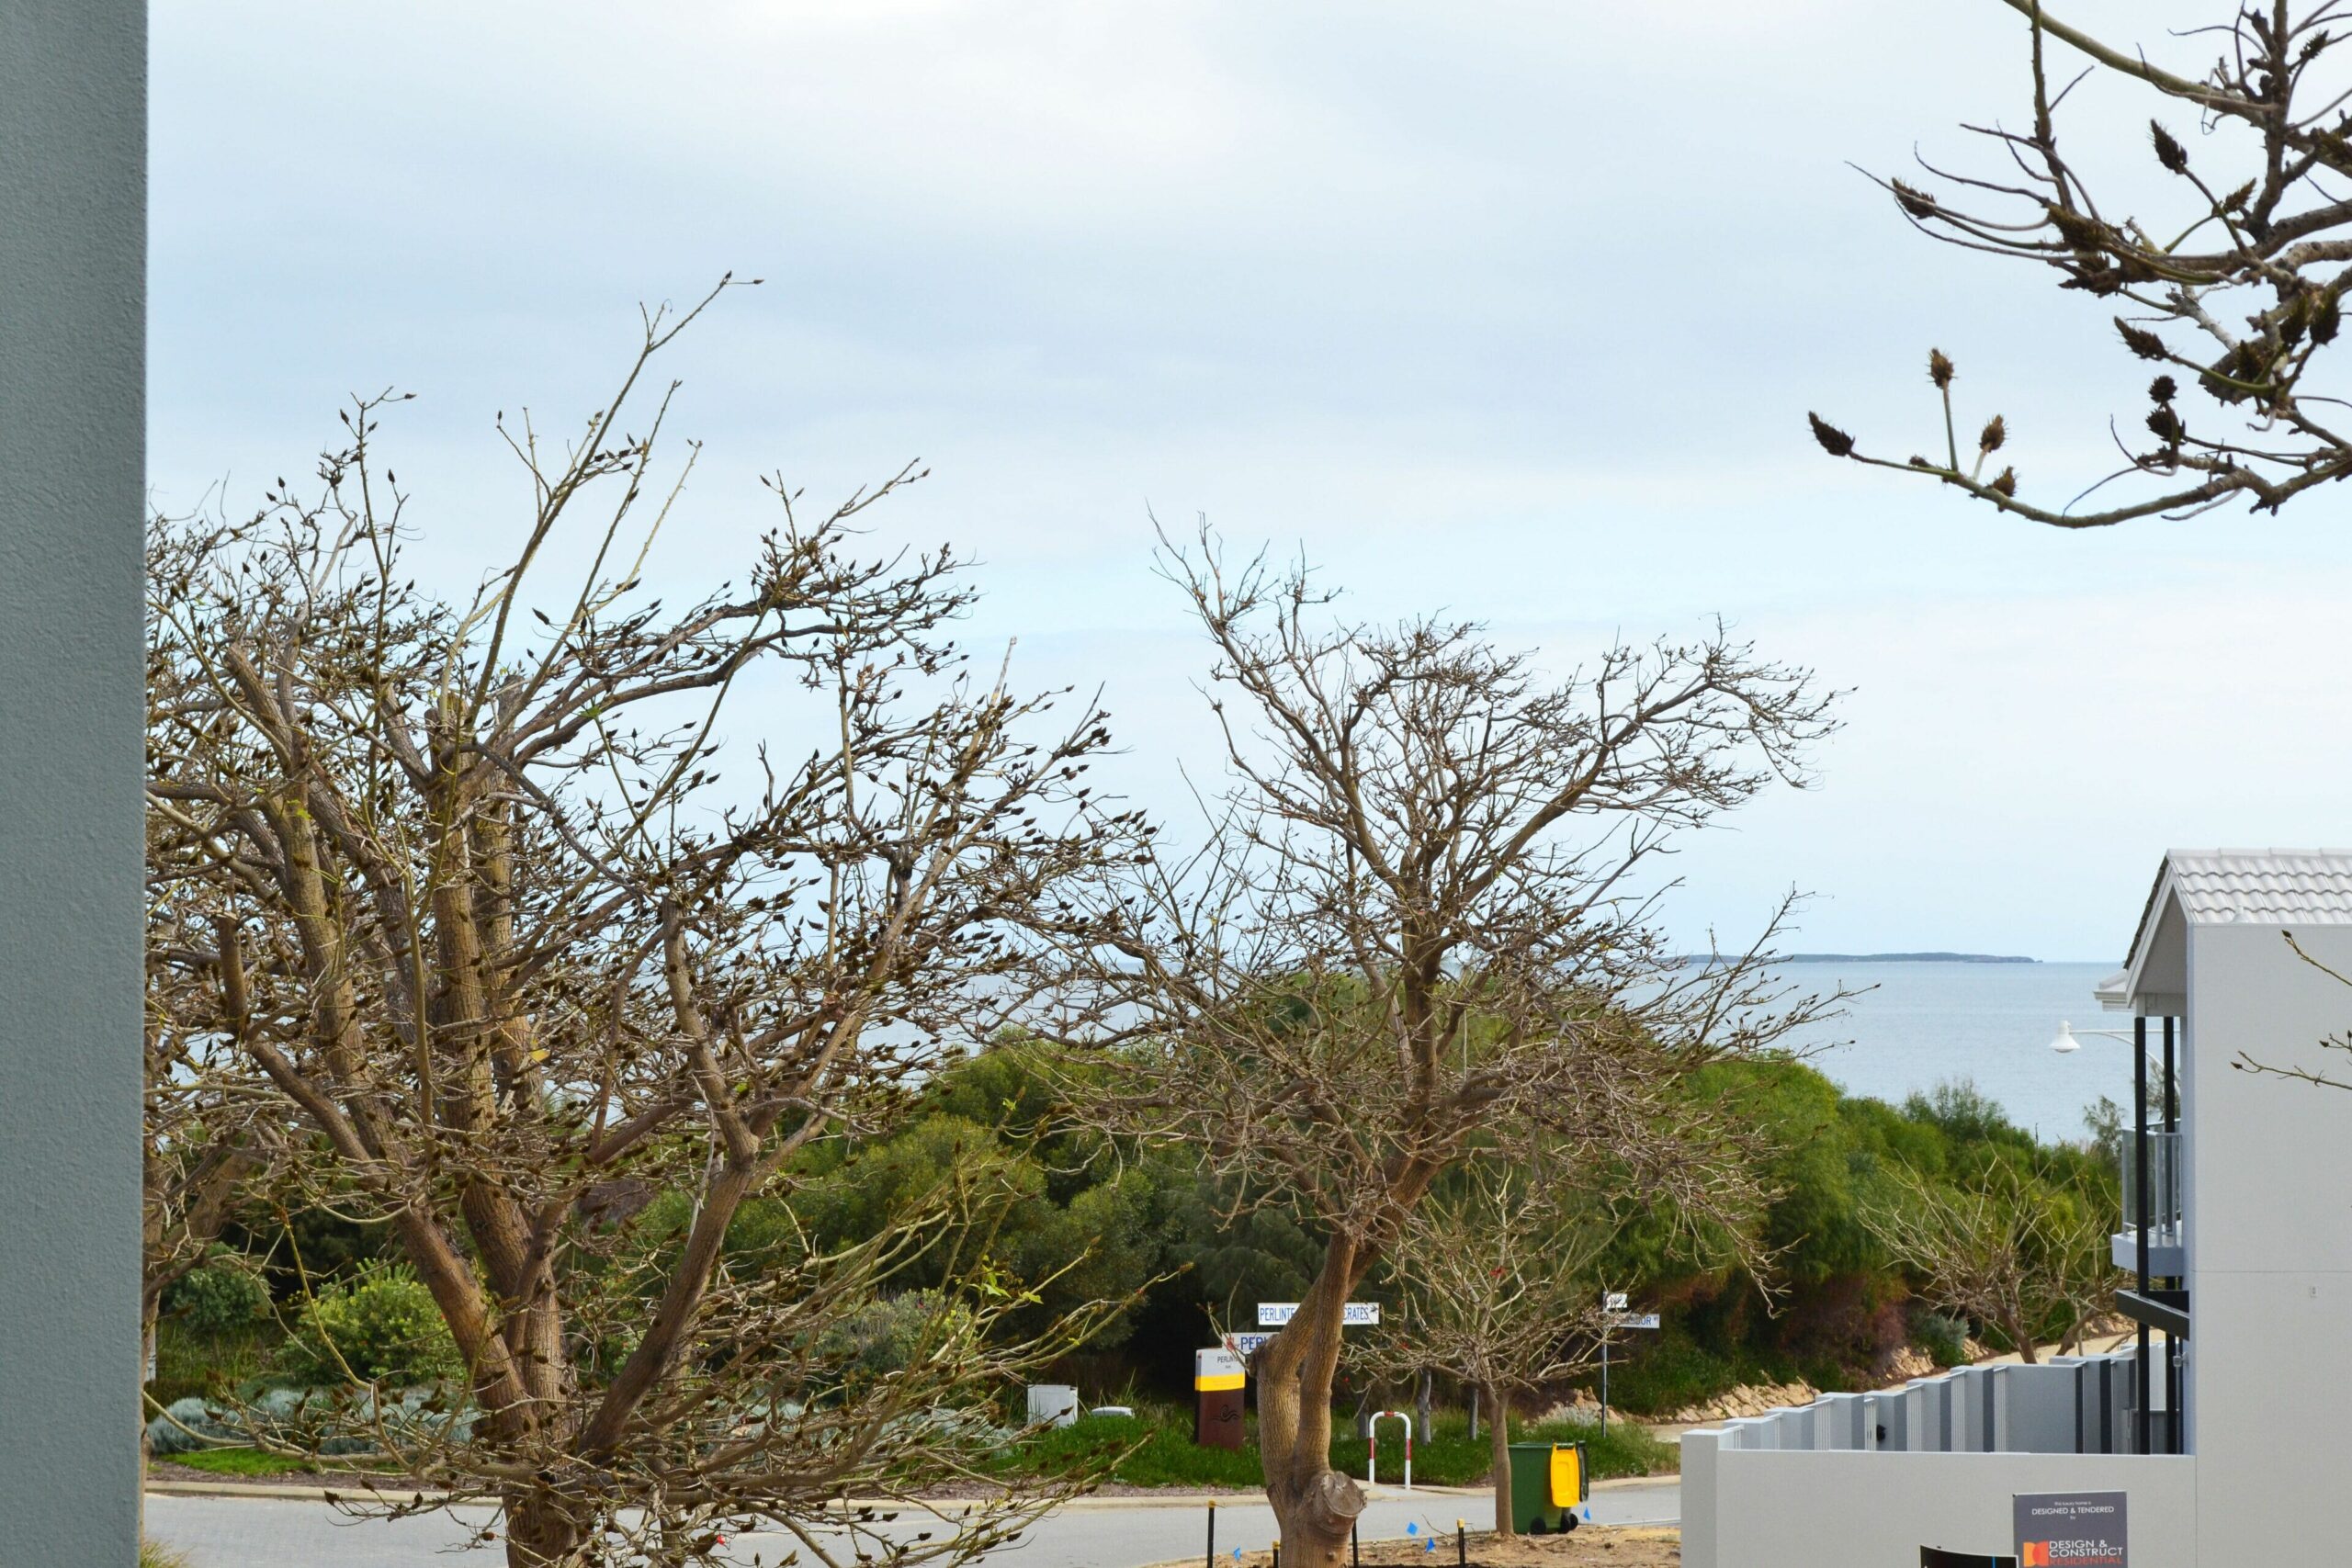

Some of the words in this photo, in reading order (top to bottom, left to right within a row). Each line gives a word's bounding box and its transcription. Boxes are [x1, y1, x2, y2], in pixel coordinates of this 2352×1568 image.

[1342, 1306, 1369, 1320] CRATES
[2031, 1507, 2069, 1516] DESIGNED
[2070, 1506, 2076, 1515] &
[2077, 1506, 2115, 1514] TENDERED
[2049, 1540, 2095, 1550] DESIGN
[2098, 1539, 2108, 1548] &
[2049, 1547, 2123, 1558] CONSTRUCT
[2049, 1556, 2123, 1566] RESIDENTIAL
